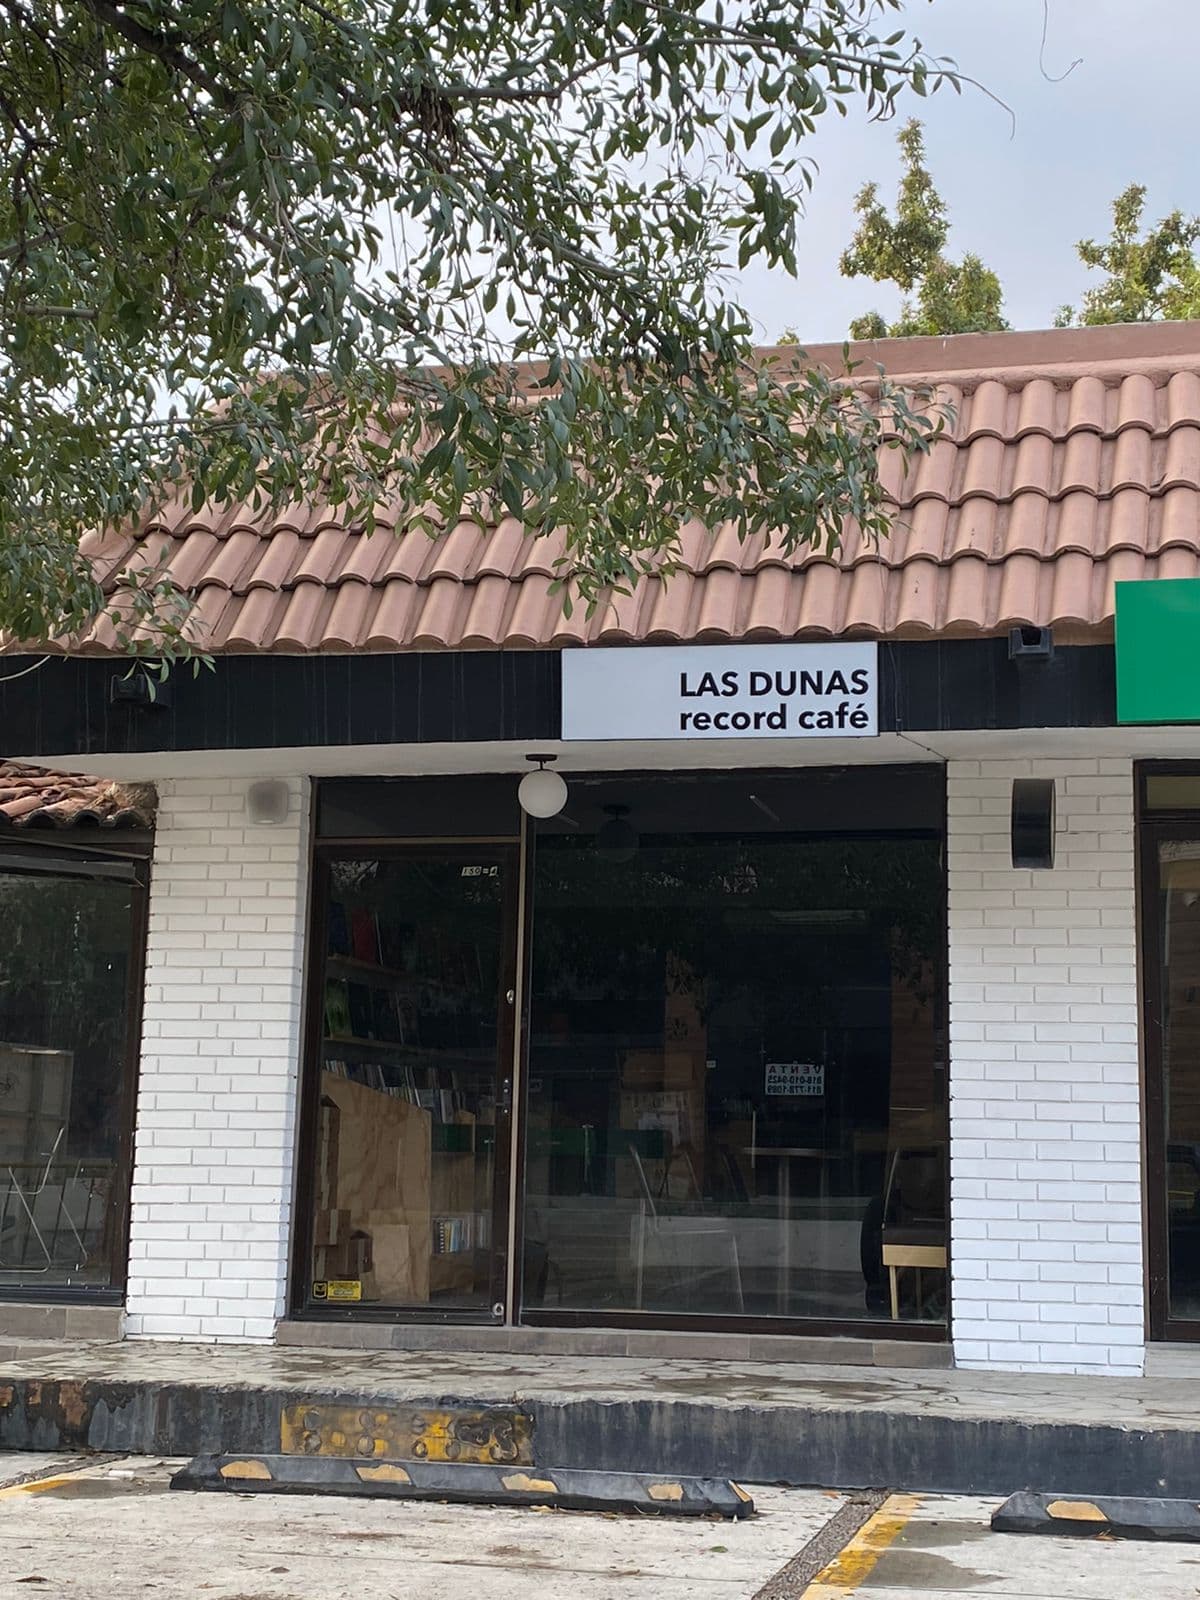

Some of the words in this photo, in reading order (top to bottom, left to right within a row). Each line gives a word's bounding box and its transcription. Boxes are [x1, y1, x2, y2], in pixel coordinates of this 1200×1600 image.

[680, 671, 739, 697] LAS
[749, 669, 869, 696] DUNAS
[680, 703, 787, 731] record
[798, 702, 869, 730] café
